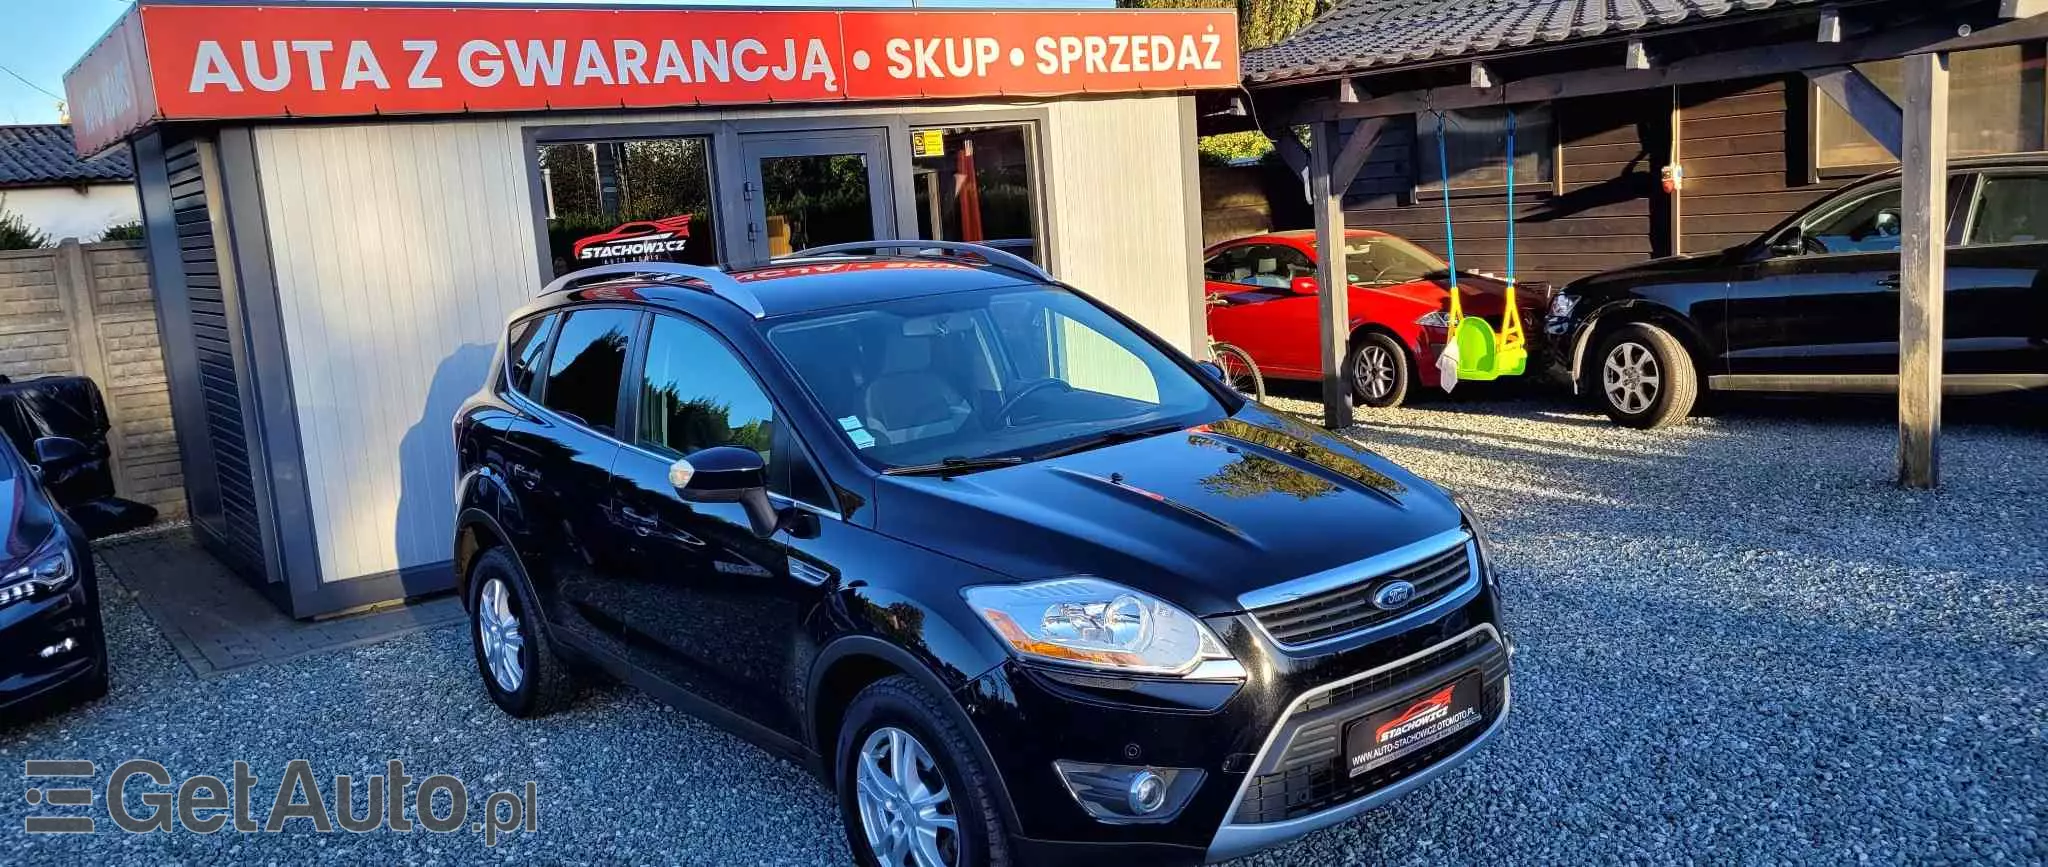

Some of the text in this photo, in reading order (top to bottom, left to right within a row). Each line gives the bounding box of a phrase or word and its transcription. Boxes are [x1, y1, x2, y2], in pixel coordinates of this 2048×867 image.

[188, 24, 1222, 93] AUTA Z GWARANCJĄ SKUP SPRZEDAŻ
[1352, 706, 1475, 766] WWW.AUTO-STACHOWICZ.OTOMOTO.PL
[1380, 705, 1449, 742] STACHOWICZ
